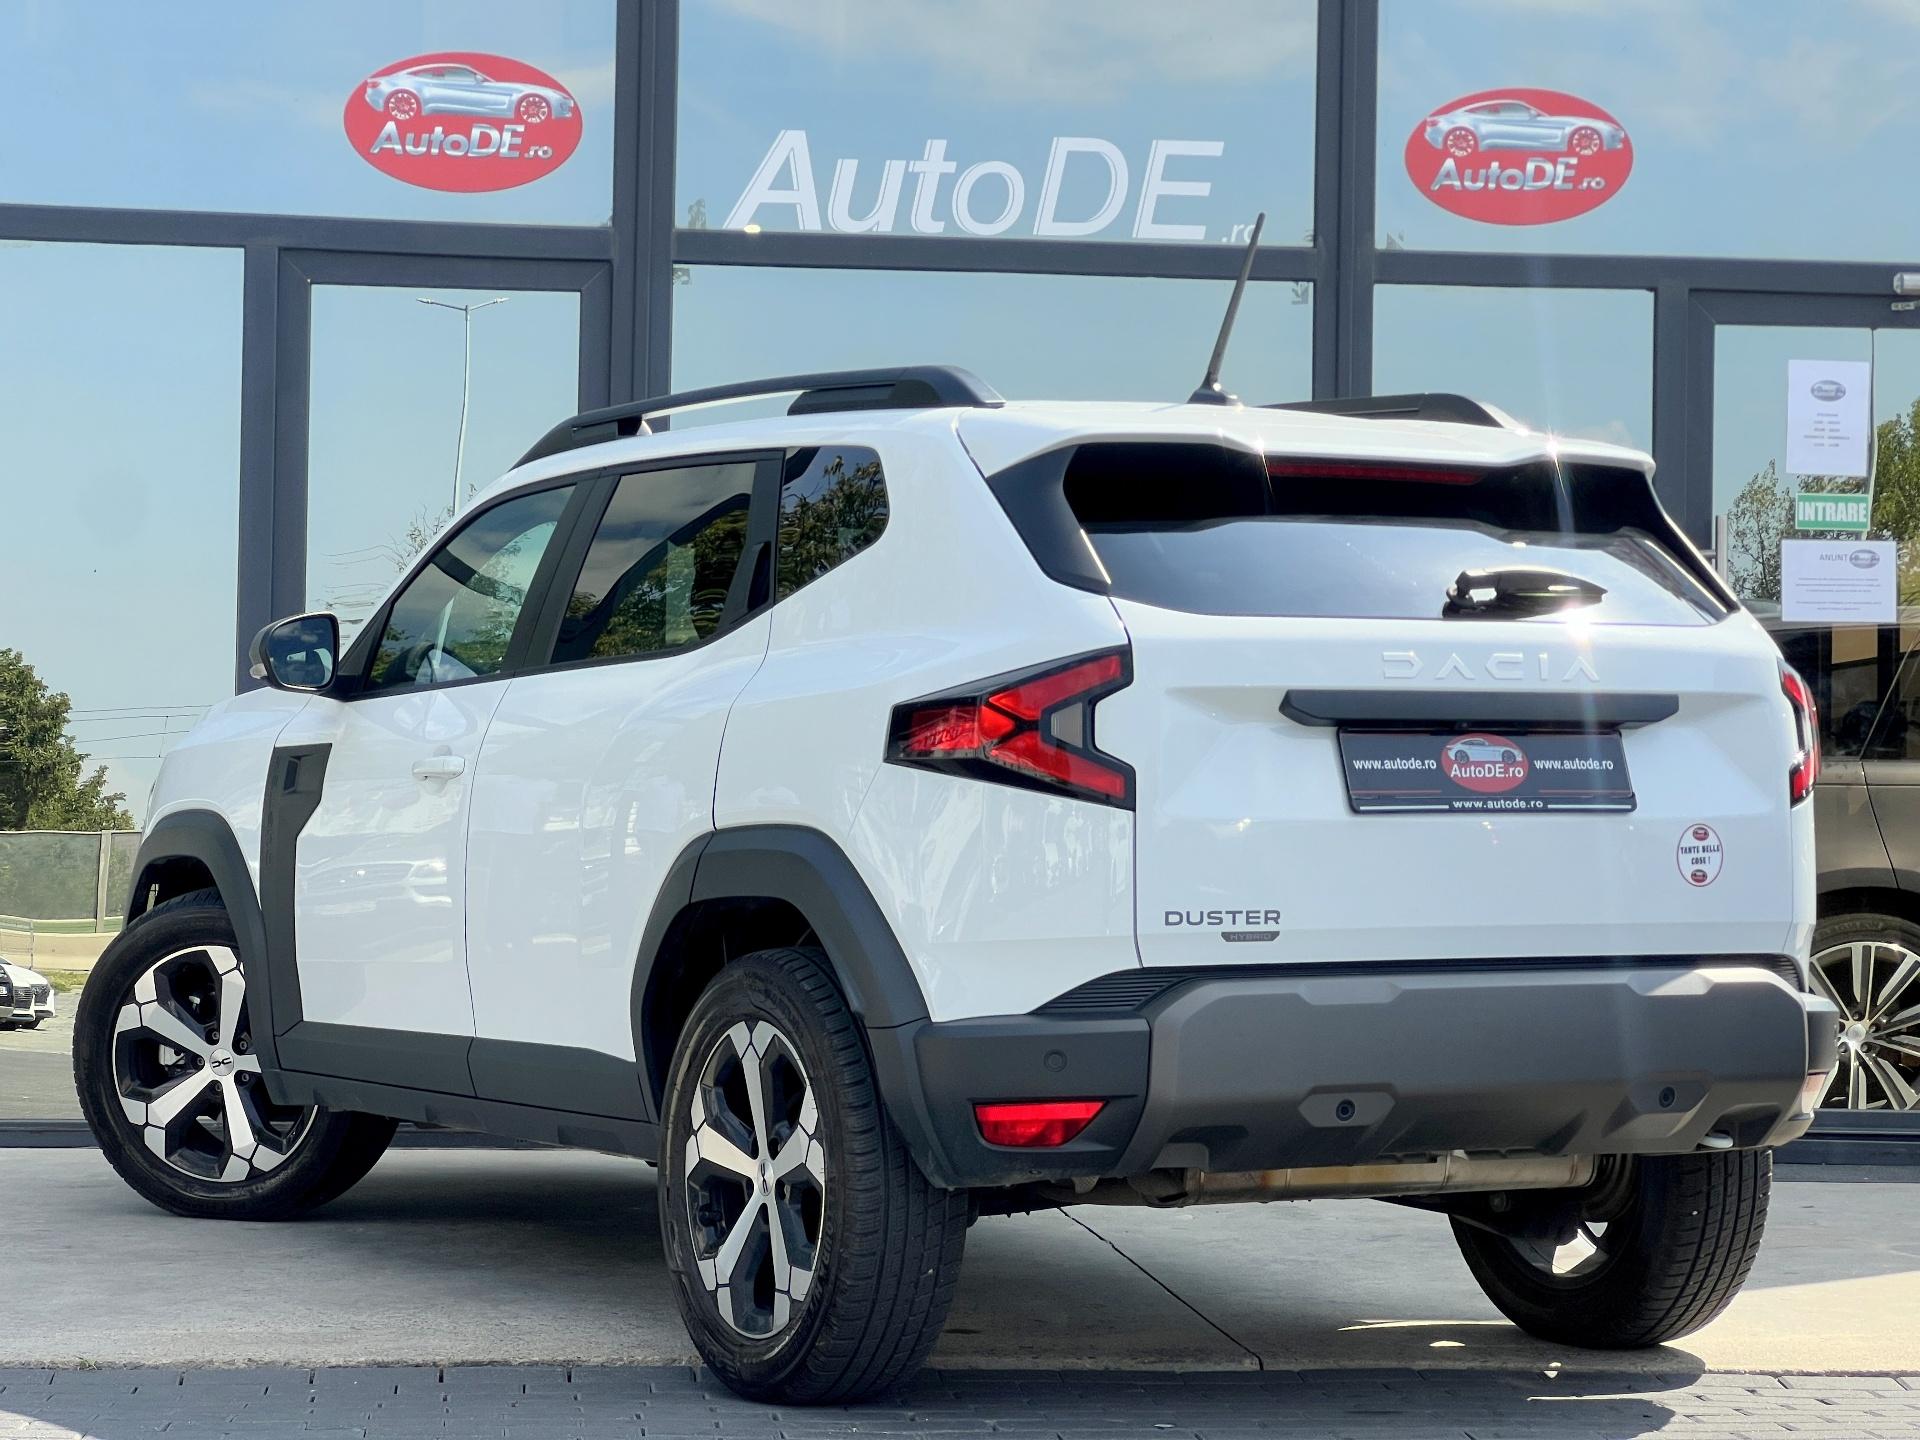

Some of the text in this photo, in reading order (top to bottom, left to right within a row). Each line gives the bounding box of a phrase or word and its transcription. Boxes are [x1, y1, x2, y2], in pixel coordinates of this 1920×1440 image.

[1798, 501, 1868, 522] INTRARE
[1382, 652, 1601, 682] DACIA
[1353, 757, 1437, 770] www.autode.ro
[1450, 763, 1524, 778] AutoDE.ro
[1534, 757, 1614, 771] www.autode.ro
[1453, 799, 1543, 809] www.autode.ro
[1164, 910, 1281, 926] DUSTER
[1230, 932, 1272, 941] HYBRID
